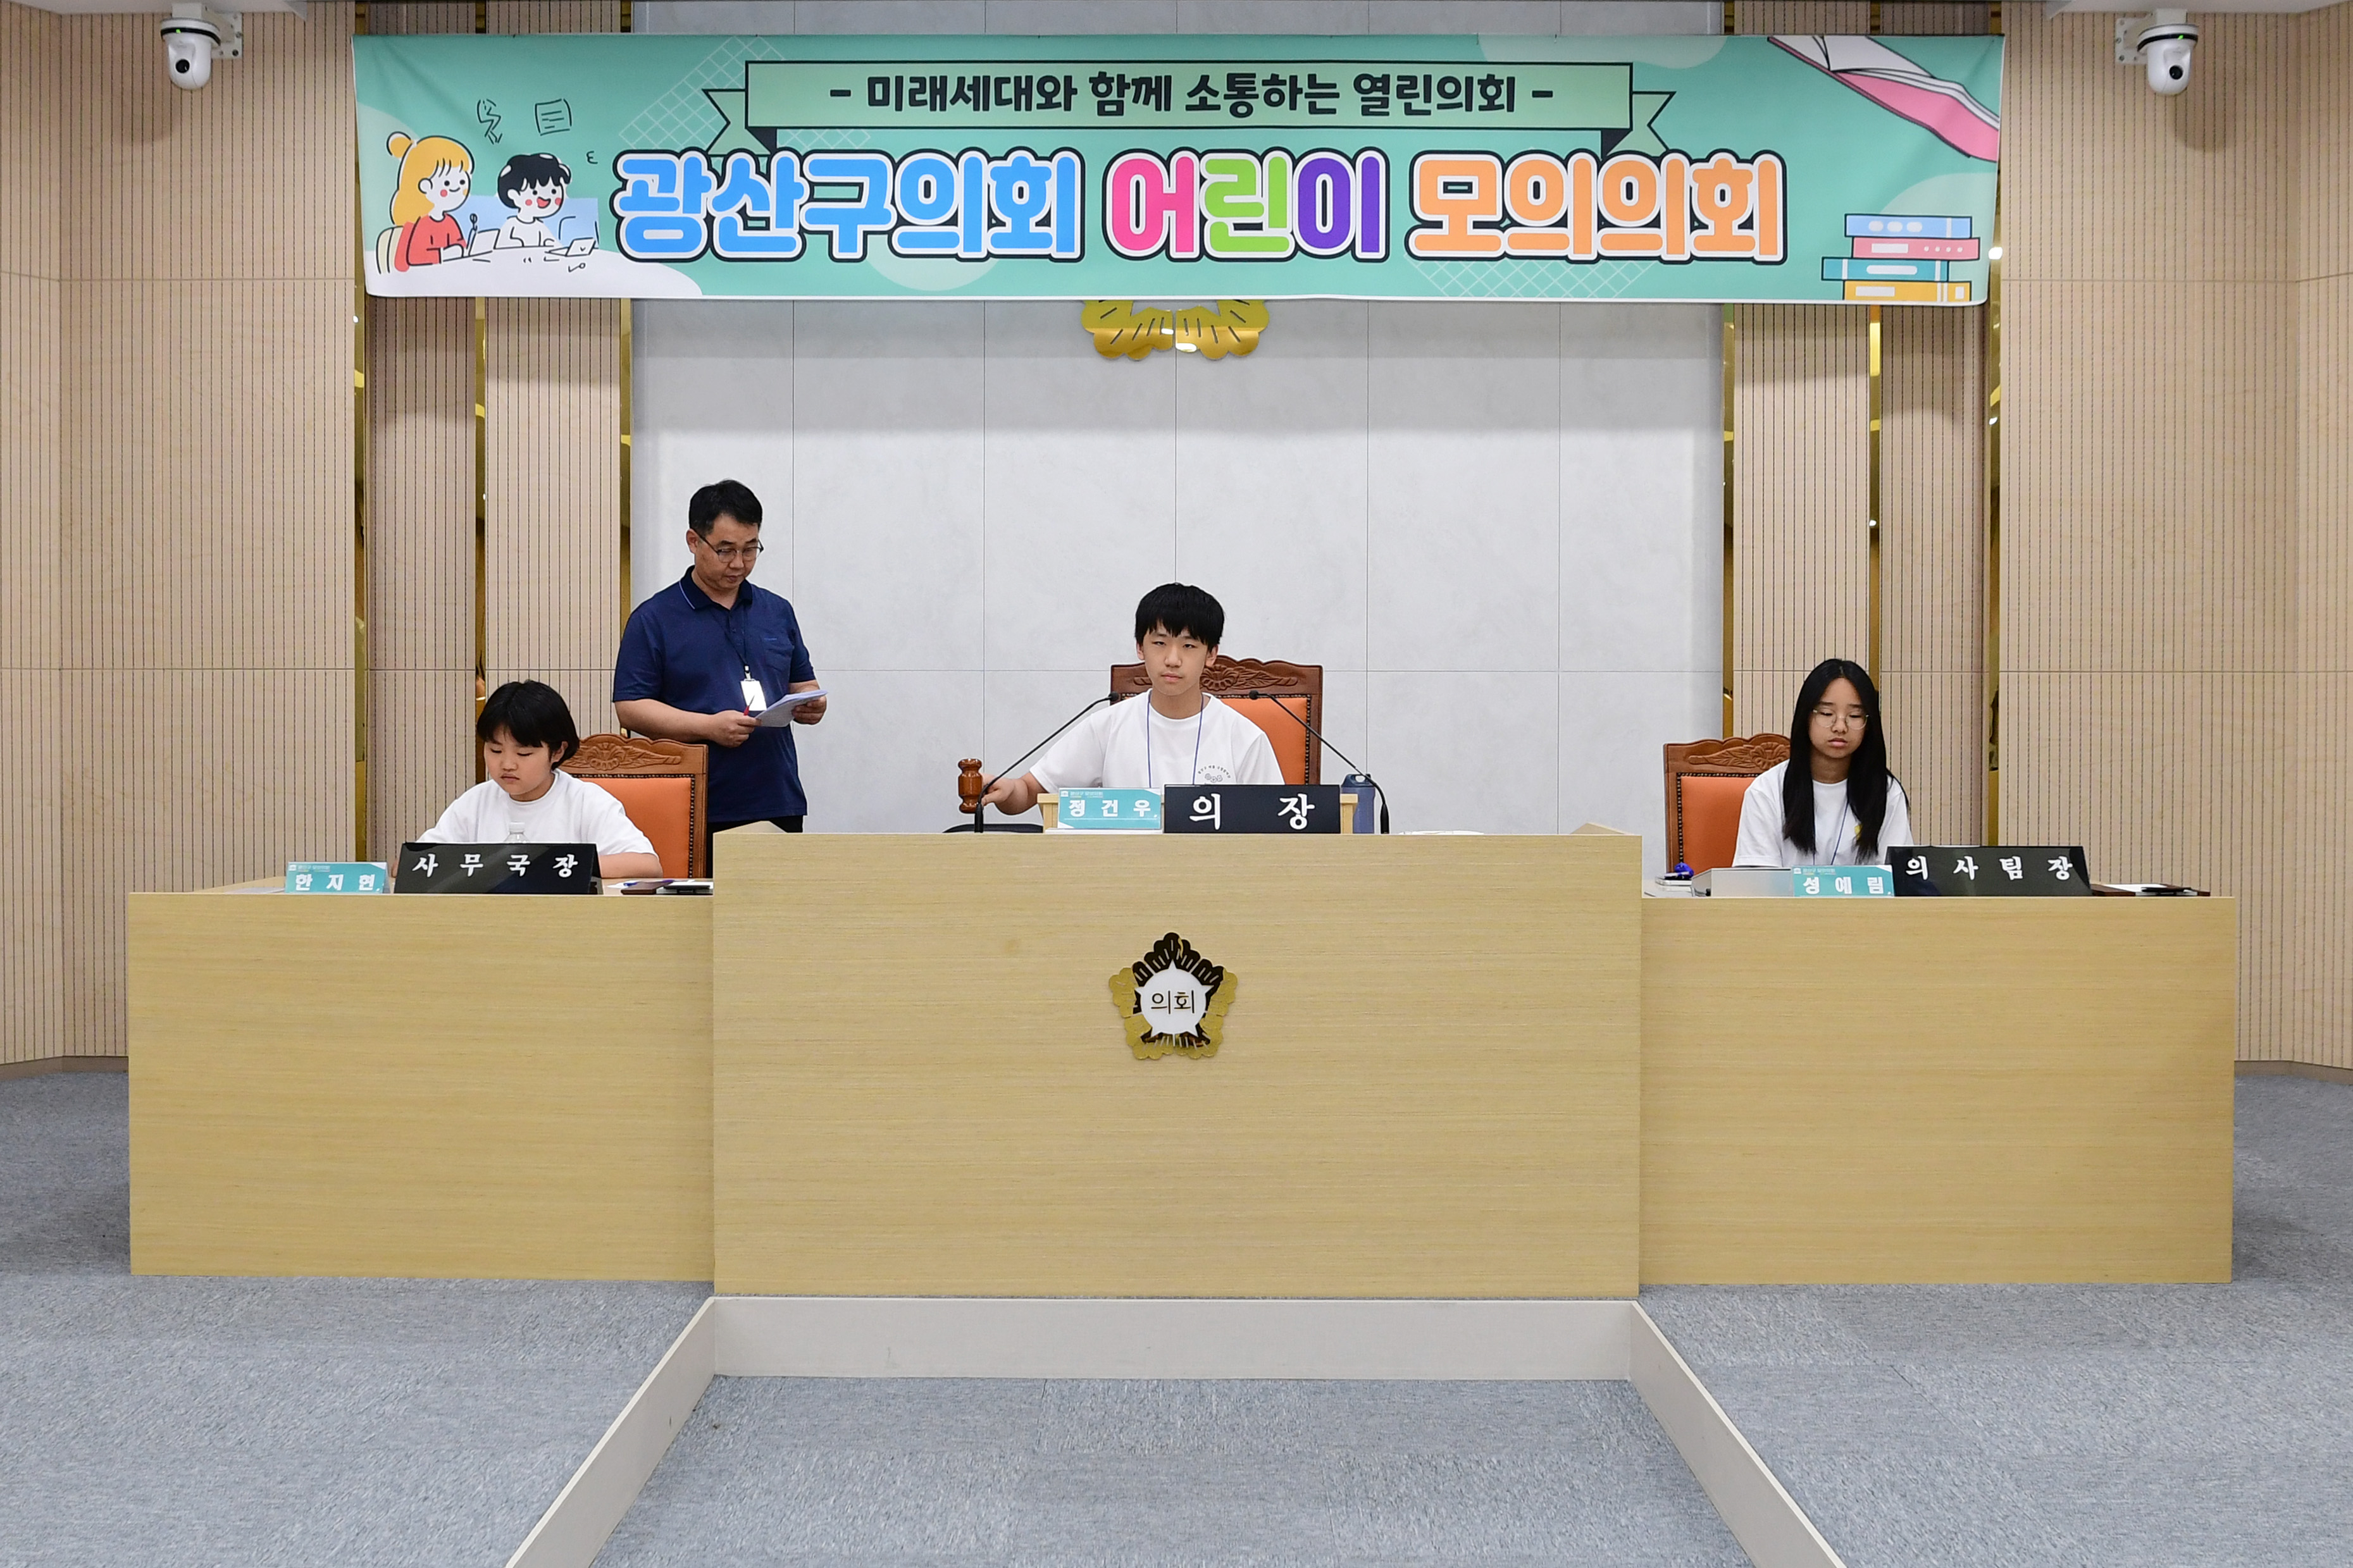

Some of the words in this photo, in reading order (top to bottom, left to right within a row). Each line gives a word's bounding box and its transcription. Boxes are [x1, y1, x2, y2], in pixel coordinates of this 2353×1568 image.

[867, 75, 1078, 112] 미래세대와
[1089, 70, 1171, 117] 함께
[1184, 72, 1341, 118] 소통하는
[1353, 73, 1516, 116] 열린의회
[611, 147, 1085, 262] 광산구의회
[1102, 147, 1390, 262] 어린이
[1404, 148, 1787, 264] 모의의회
[1069, 799, 1151, 817] 정건우
[1189, 793, 1315, 830] 의장
[412, 853, 578, 878] 사무국장
[1906, 855, 2074, 880] 의사팀장
[1151, 990, 1195, 1015] 의회
